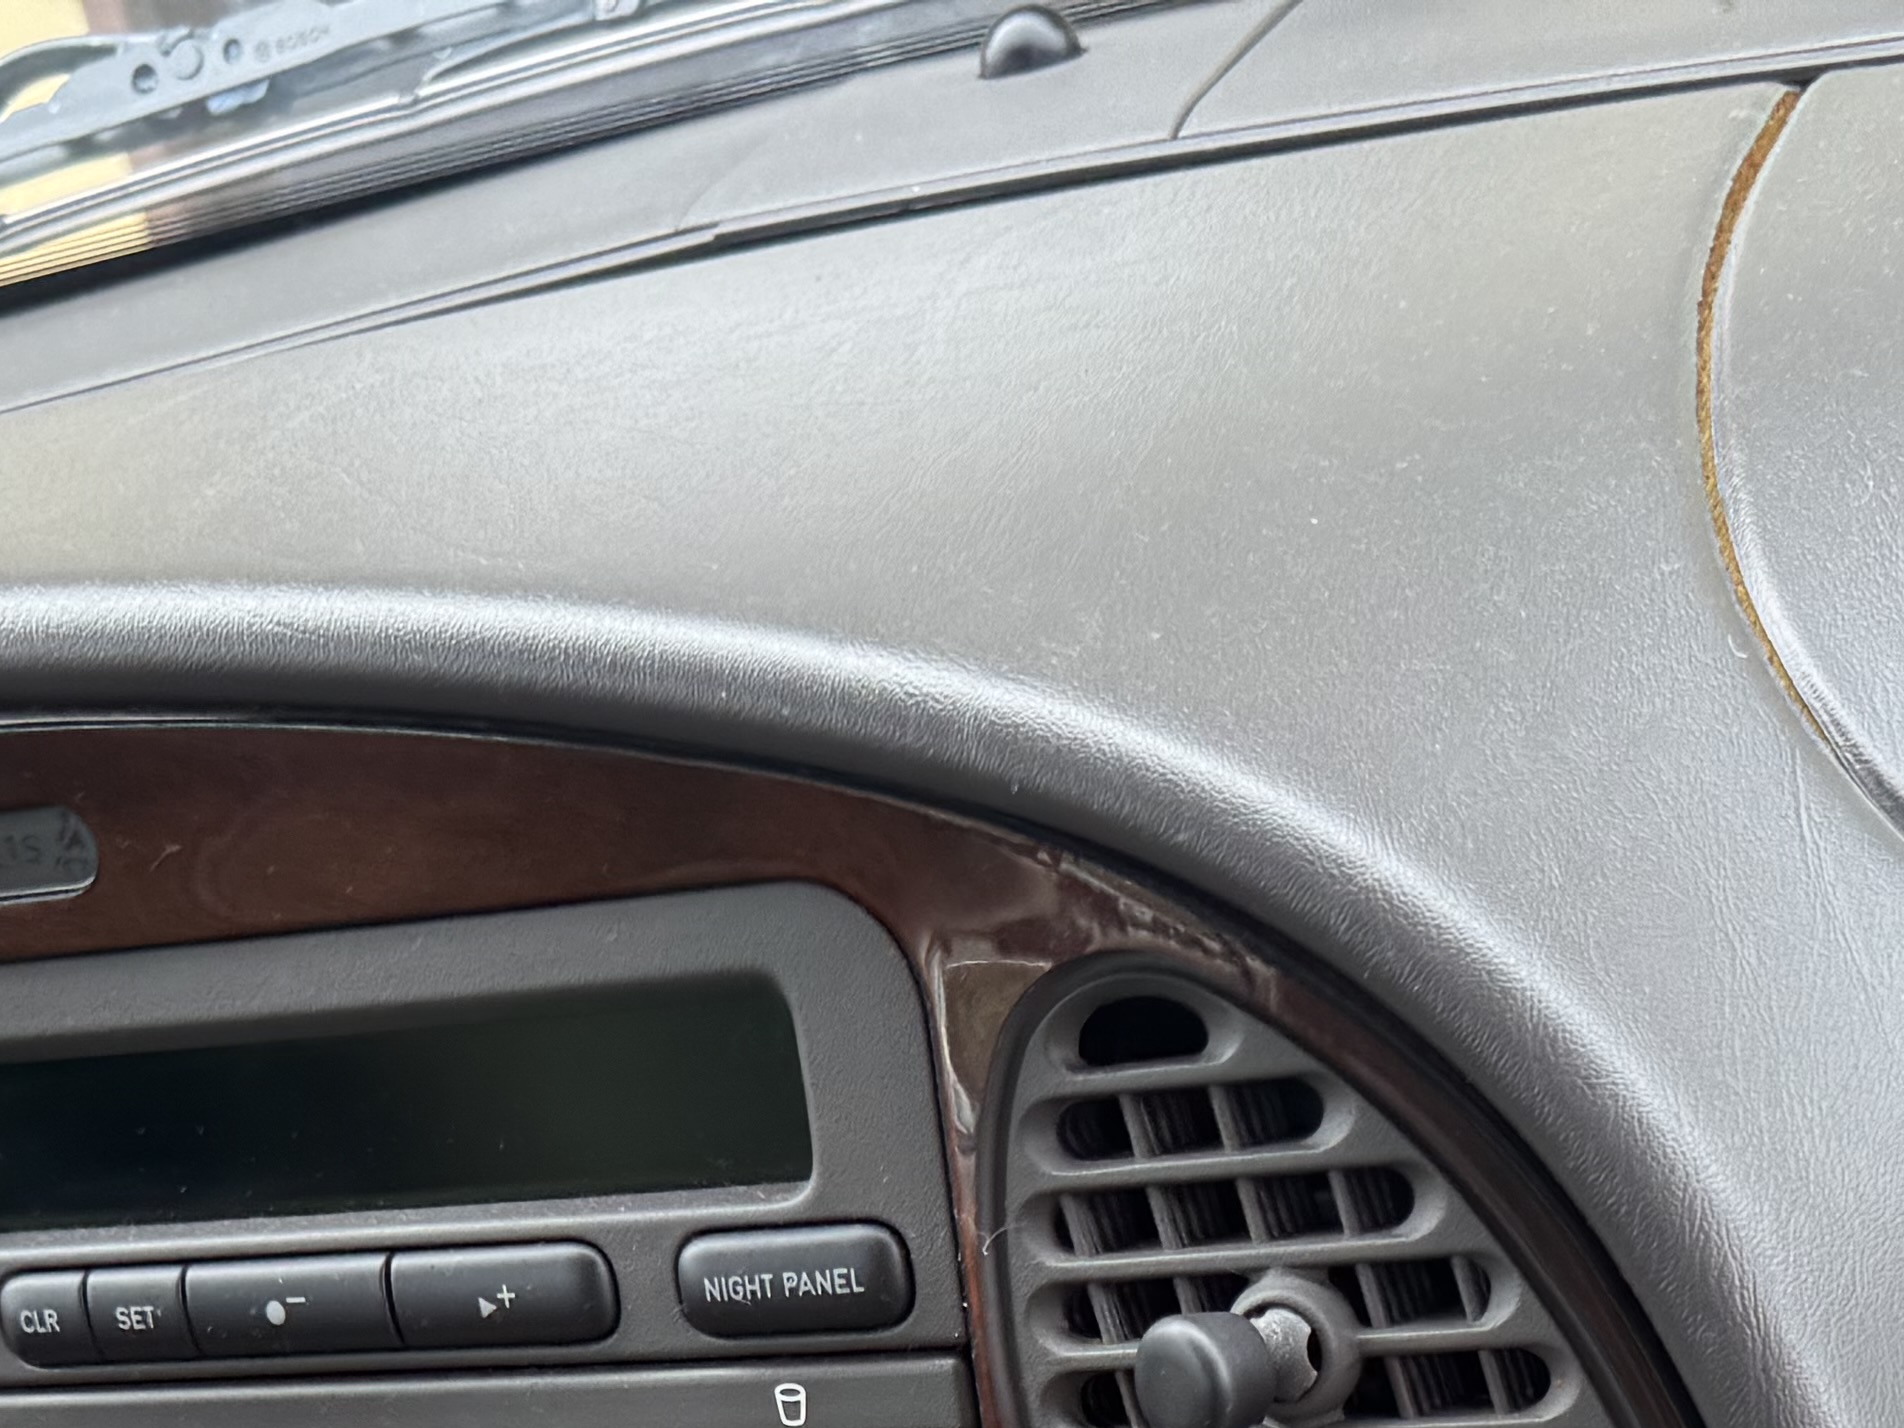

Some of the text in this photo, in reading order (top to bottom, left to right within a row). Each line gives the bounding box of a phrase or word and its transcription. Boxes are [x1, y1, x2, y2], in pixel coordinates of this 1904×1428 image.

[704, 1267, 865, 1302] NIGHT PANEL
[20, 1308, 61, 1334] CLR
[114, 1306, 156, 1332] SET
